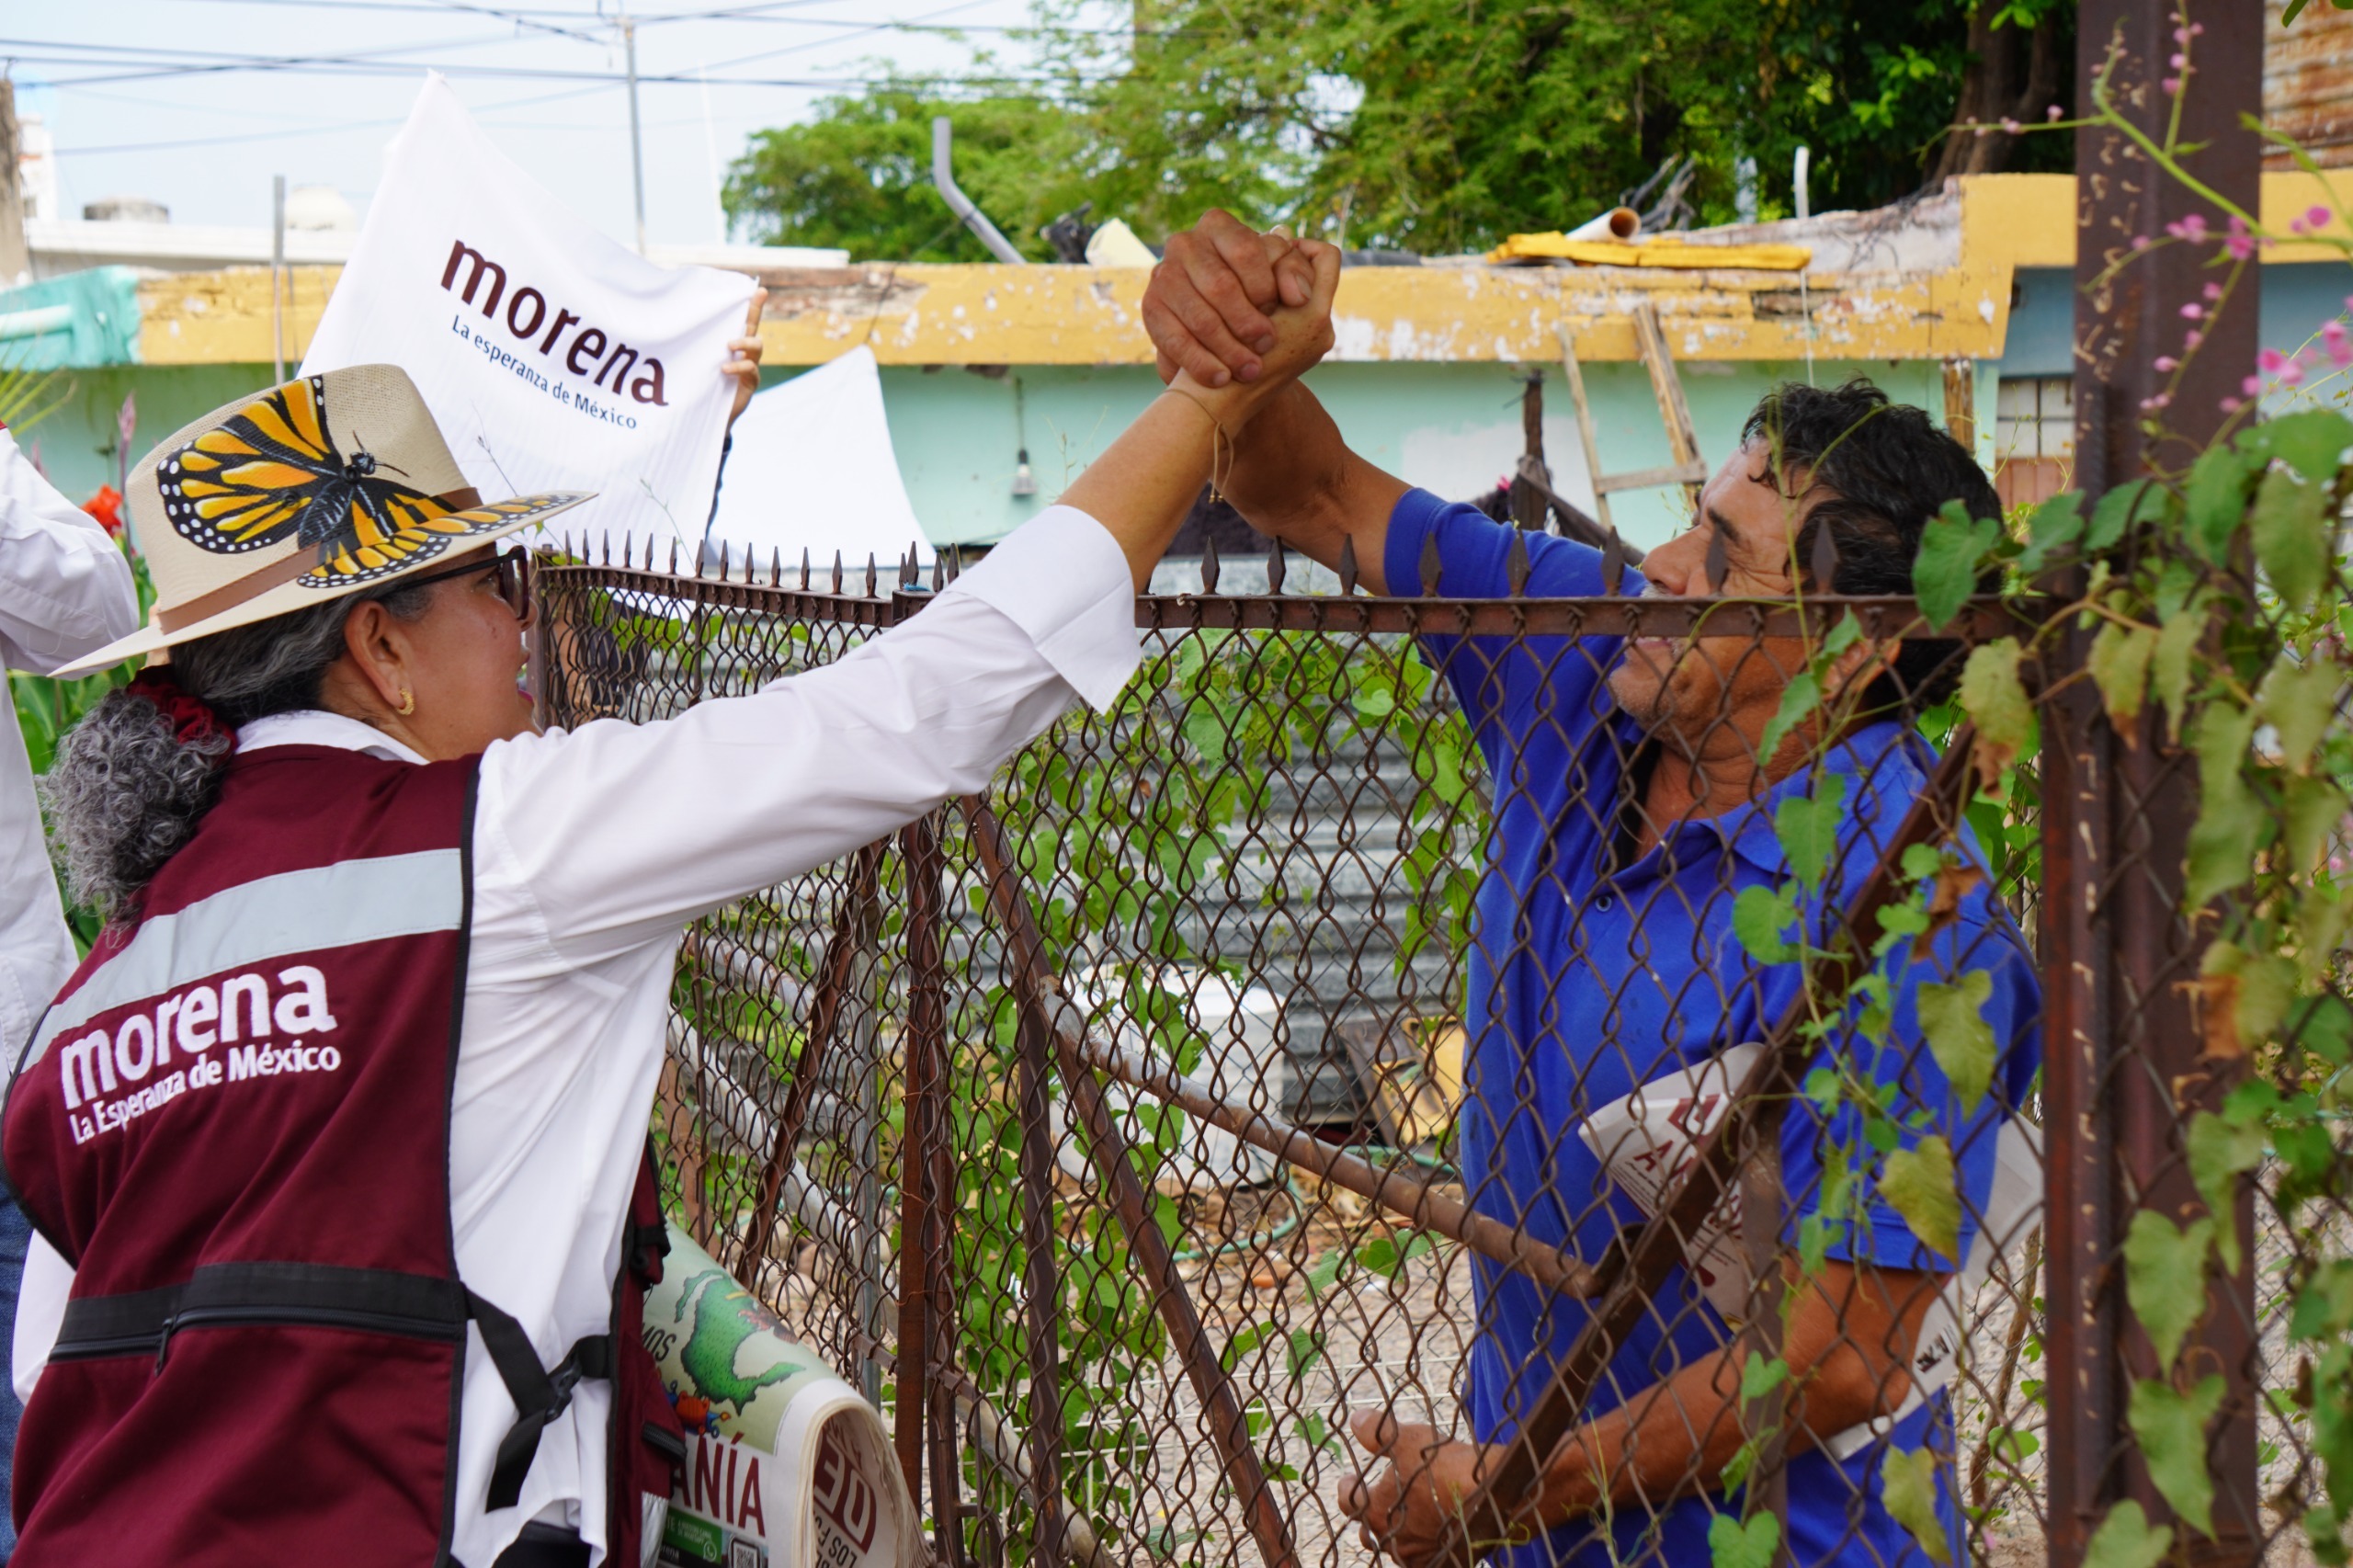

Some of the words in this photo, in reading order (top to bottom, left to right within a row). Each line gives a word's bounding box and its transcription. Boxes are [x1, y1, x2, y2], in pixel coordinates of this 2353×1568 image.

[441, 240, 669, 406] morena
[452, 314, 470, 340] La
[474, 335, 548, 392] esperanza
[551, 381, 570, 404] de
[574, 392, 638, 429] México
[61, 965, 338, 1110] morena
[70, 1113, 95, 1145] La
[93, 1070, 186, 1131] Esperanza
[189, 1053, 222, 1089] de
[229, 1040, 341, 1082] México
